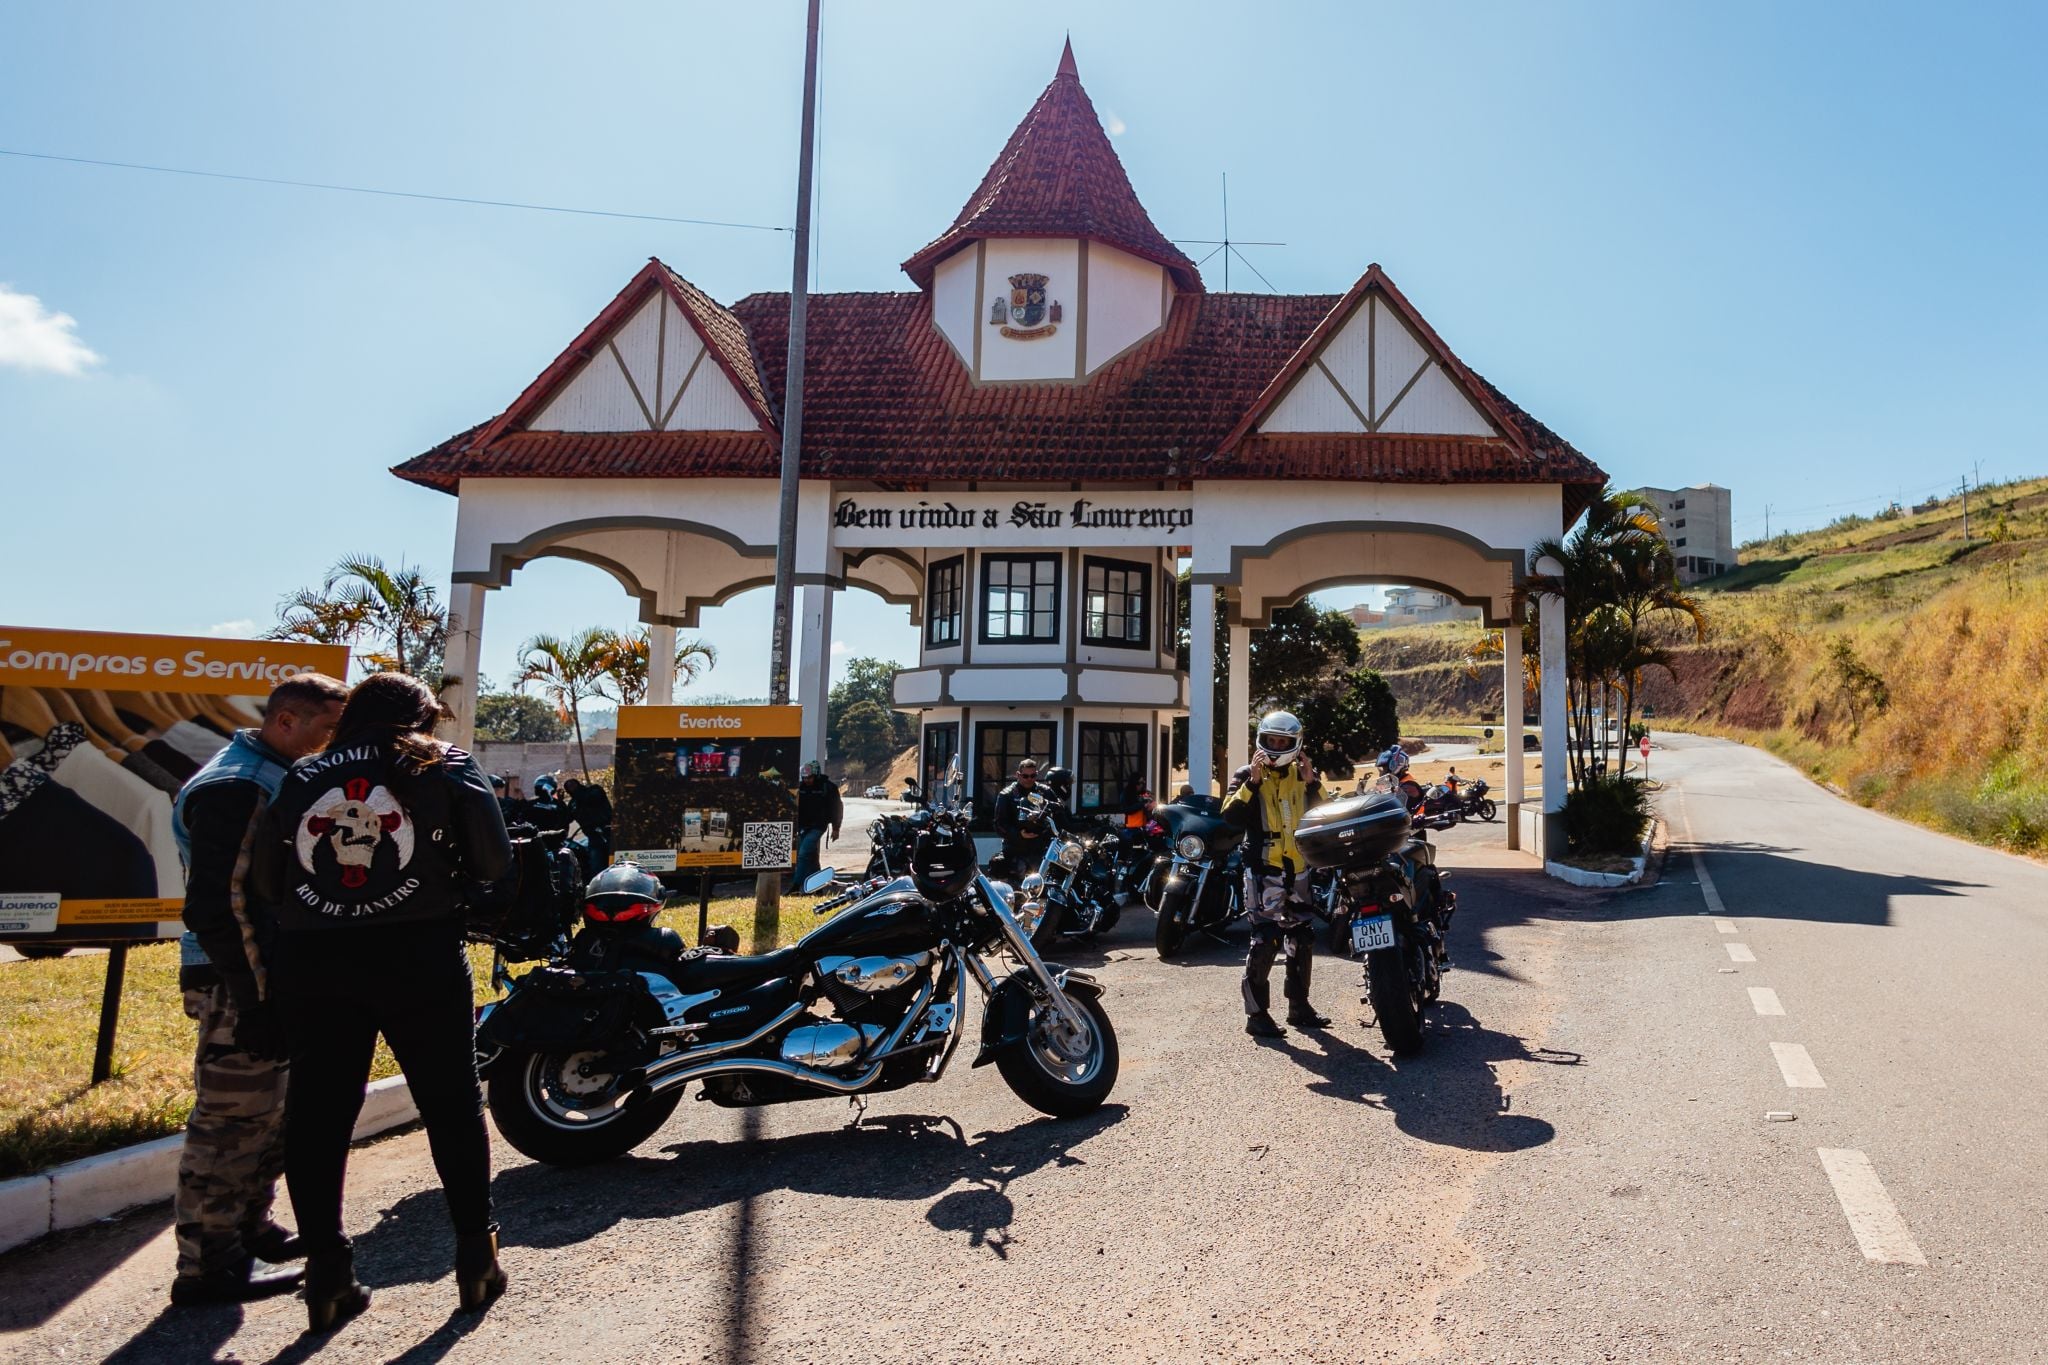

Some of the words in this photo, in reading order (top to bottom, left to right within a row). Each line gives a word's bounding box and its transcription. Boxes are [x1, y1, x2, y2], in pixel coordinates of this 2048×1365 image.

[834, 498, 892, 529] Bem
[899, 501, 976, 529] vindo
[982, 508, 999, 528] a
[1006, 501, 1063, 529] São
[1069, 498, 1194, 534] Lourenço
[153, 657, 177, 676] e
[679, 713, 742, 729] Eventos
[1338, 829, 1355, 838] GIVI
[0, 899, 58, 911] Lourenço
[296, 883, 320, 906] RIO
[321, 903, 345, 917] DE
[352, 877, 421, 917] JANEIRO
[1361, 921, 1384, 937] QNY
